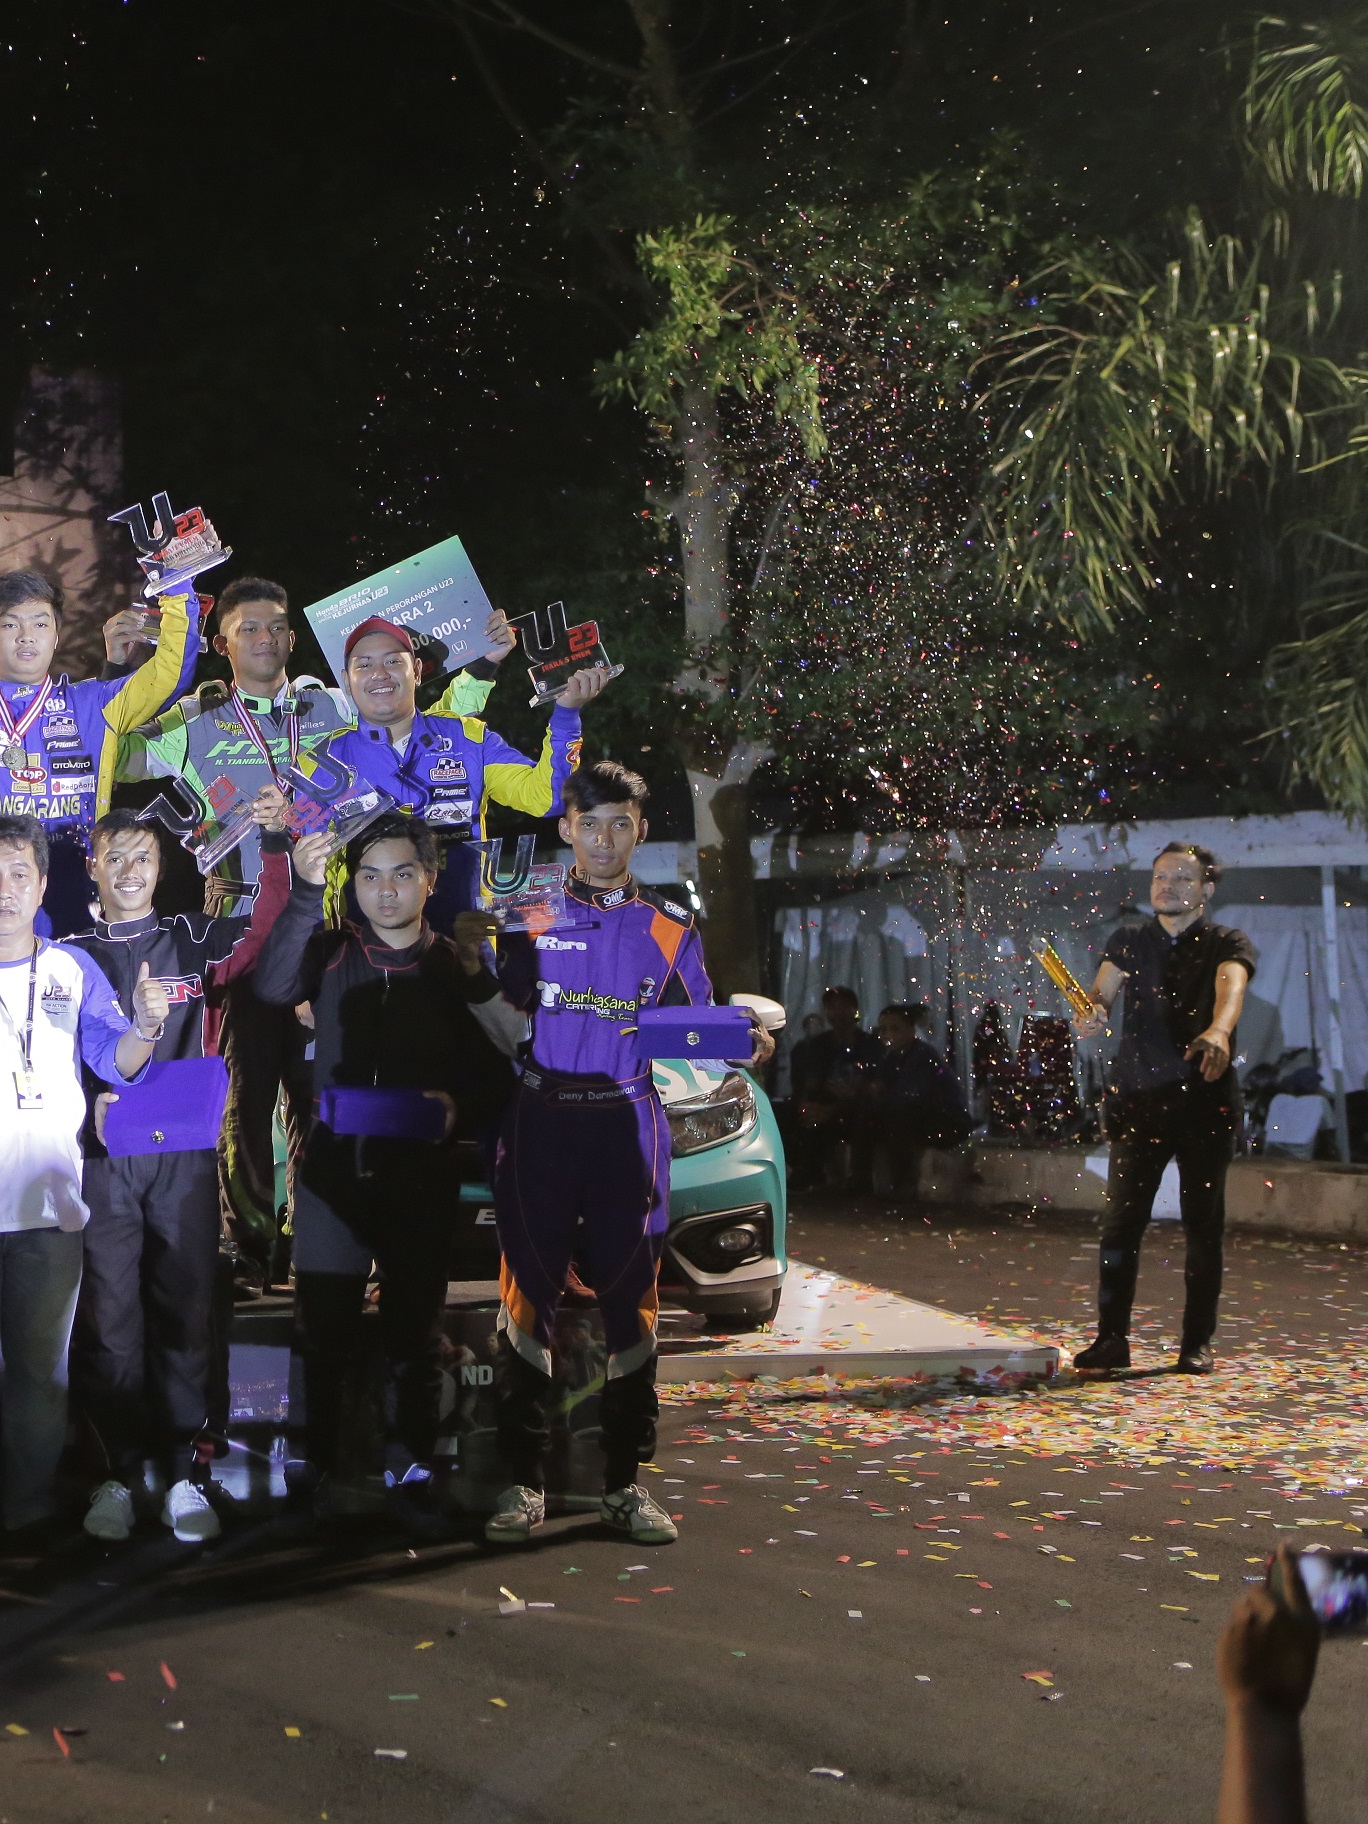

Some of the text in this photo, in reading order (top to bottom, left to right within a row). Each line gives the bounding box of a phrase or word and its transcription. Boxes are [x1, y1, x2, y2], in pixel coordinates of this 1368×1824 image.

[315, 587, 371, 618] Honda BRIO
[332, 597, 372, 619] KEJURNAS
[371, 585, 389, 600] U23
[386, 585, 438, 616] PERORANGAN
[438, 577, 454, 590] U23
[391, 600, 434, 627] ARA 2
[435, 831, 470, 840] TOMOTO
[602, 888, 626, 908] OMP
[663, 900, 689, 920] OMP
[565, 1003, 611, 1015] CATERING
[558, 1085, 636, 1101] Deny Darmawan
